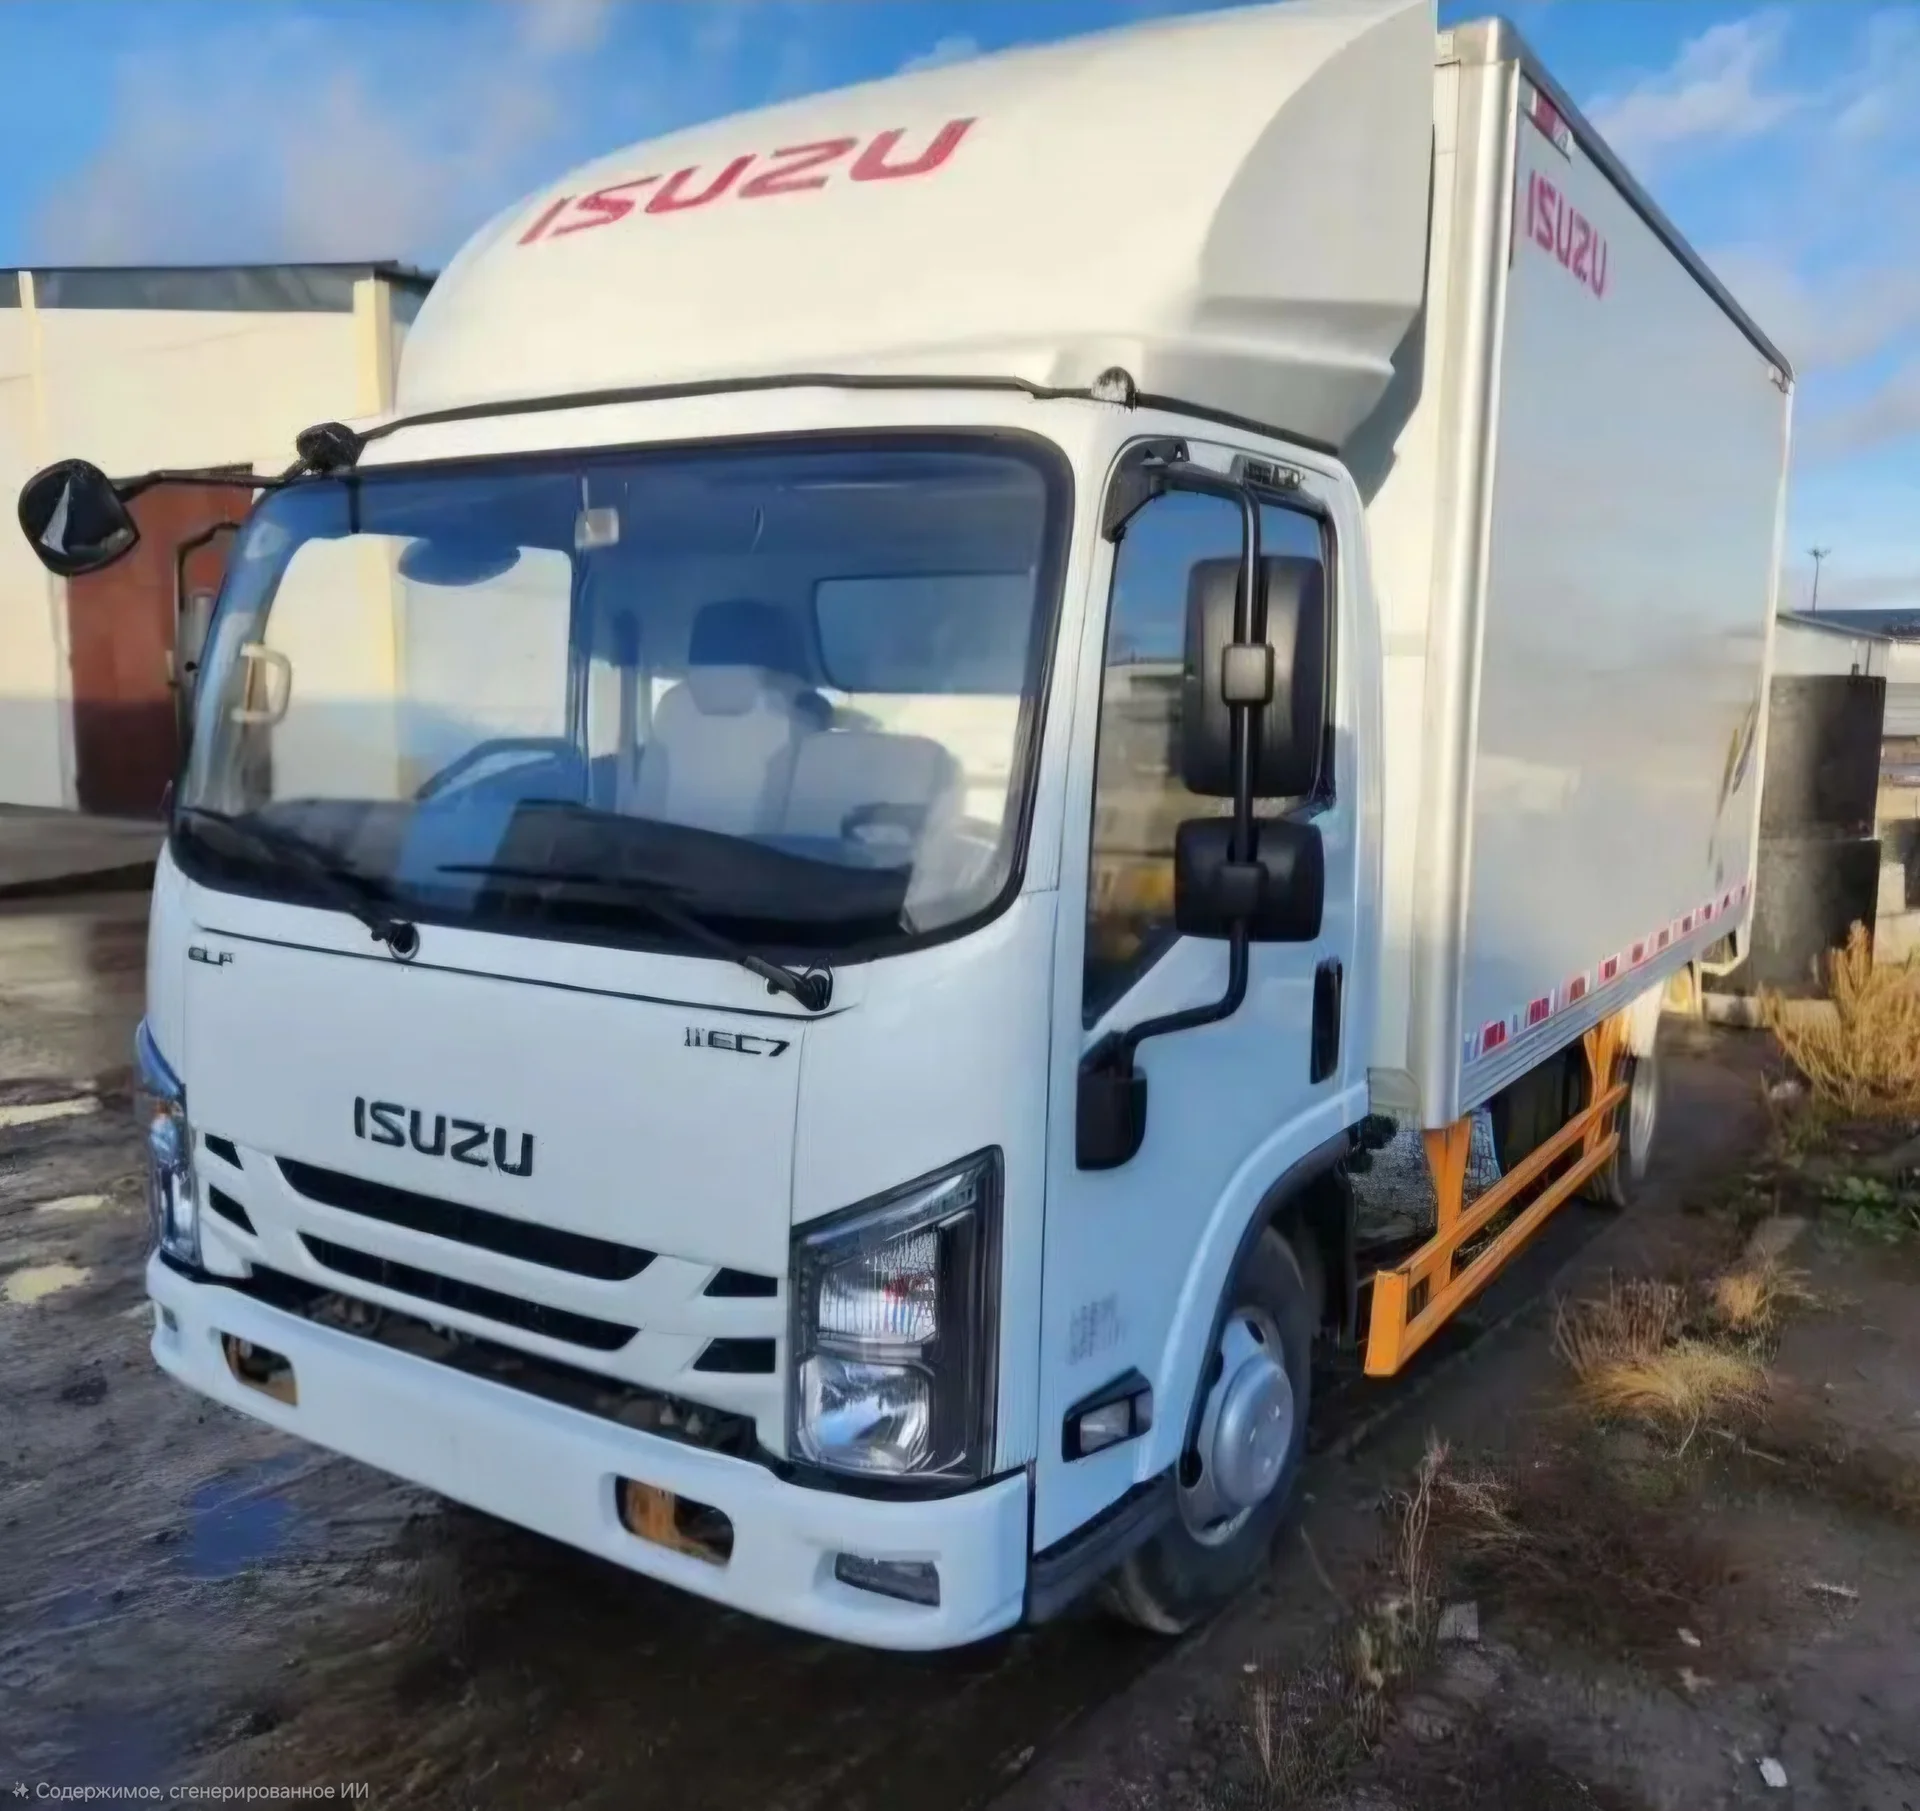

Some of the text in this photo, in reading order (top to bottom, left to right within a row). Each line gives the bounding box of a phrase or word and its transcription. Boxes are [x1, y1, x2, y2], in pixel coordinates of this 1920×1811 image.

[517, 116, 978, 246] ISUZU
[1527, 169, 1608, 299] ISUZU
[354, 1095, 534, 1176] ISUZU
